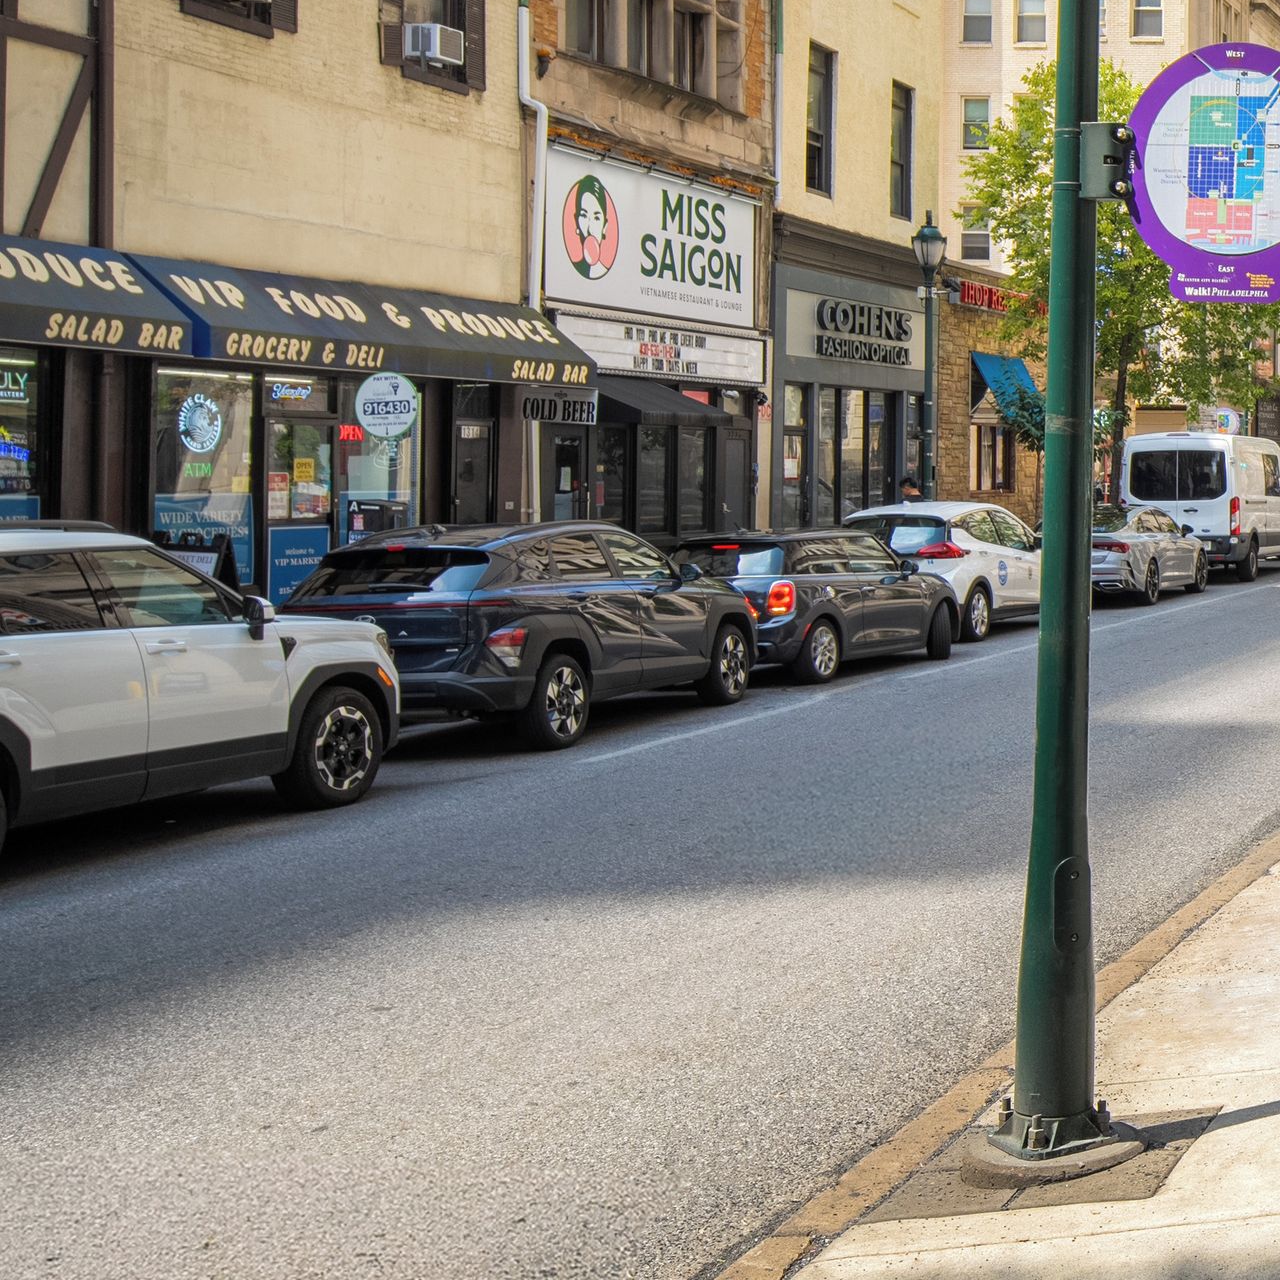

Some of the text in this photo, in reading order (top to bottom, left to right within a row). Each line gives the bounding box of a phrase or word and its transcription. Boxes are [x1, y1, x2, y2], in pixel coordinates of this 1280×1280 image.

[1225, 49, 1245, 58] WEST
[662, 189, 726, 244] MISS
[640, 233, 742, 294] SAIGON
[640, 286, 678, 301] VIETNAMESE
[679, 293, 713, 307] RESTAURANT
[720, 301, 743, 312] LOUNGE
[1211, 287, 1269, 297] PHILADELPHIA
[169, 274, 560, 344] VIP FOOD & PRODUCE
[817, 298, 913, 343] COHEN'S
[45, 313, 184, 351] SALAD BAR
[225, 332, 385, 369] GROCERY & DELI
[820, 335, 912, 366] FASHION OPTICAL
[511, 359, 589, 385] SALAD BAR
[178, 396, 194, 432] WHITE
[192, 393, 218, 414] CLAW
[364, 401, 409, 415] 916430
[523, 397, 595, 424] COLD BEER
[183, 462, 212, 478] ATM
[160, 509, 243, 524] WIDE VARIETY
[197, 553, 213, 564] DELI
[275, 557, 289, 567] VIP
